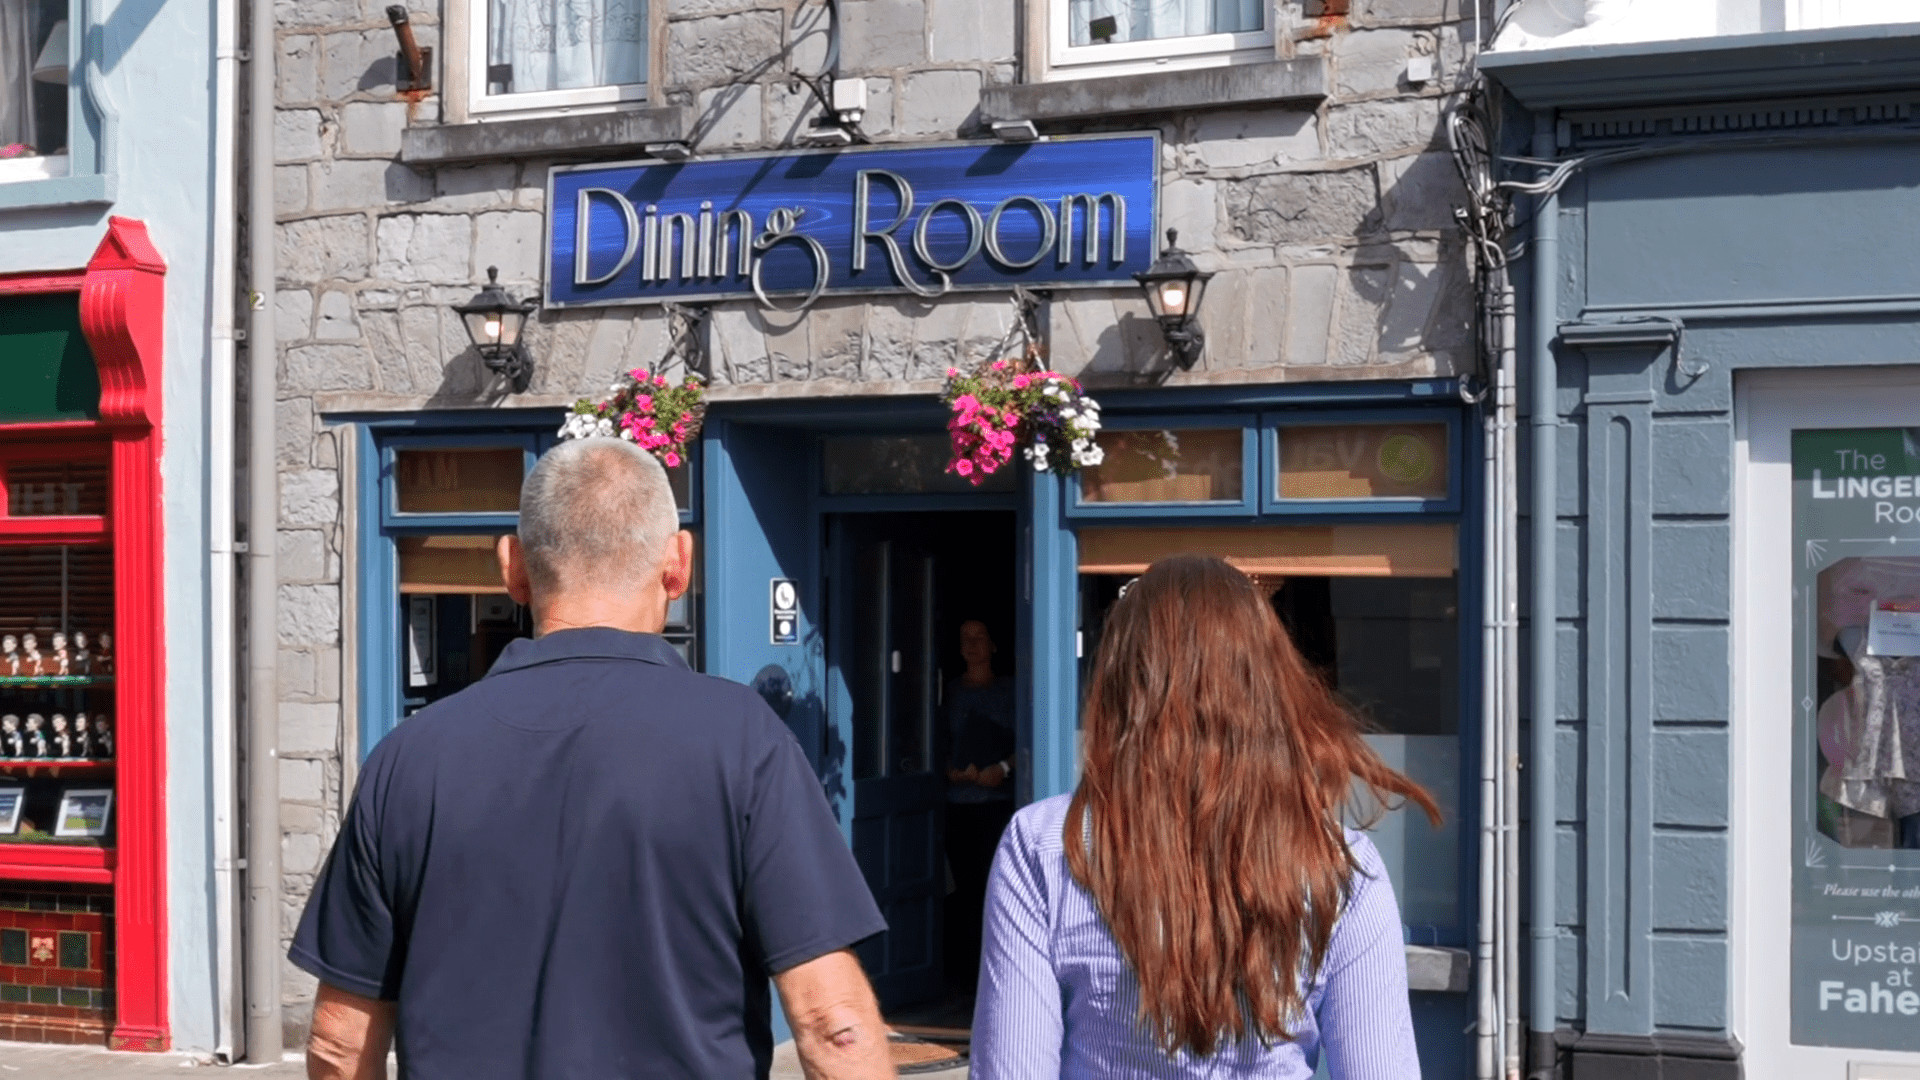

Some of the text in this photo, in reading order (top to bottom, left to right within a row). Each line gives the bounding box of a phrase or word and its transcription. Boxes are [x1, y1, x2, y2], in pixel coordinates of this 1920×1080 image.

[573, 169, 1127, 312] Dining Room
[1836, 450, 1886, 471] The
[1813, 469, 1920, 499] LINGE
[1875, 501, 1920, 524] Ro
[1823, 883, 1860, 897] Please
[1860, 888, 1881, 897] use
[1881, 884, 1900, 898] the
[1886, 967, 1913, 988] at
[1819, 980, 1920, 1016] Fahe
